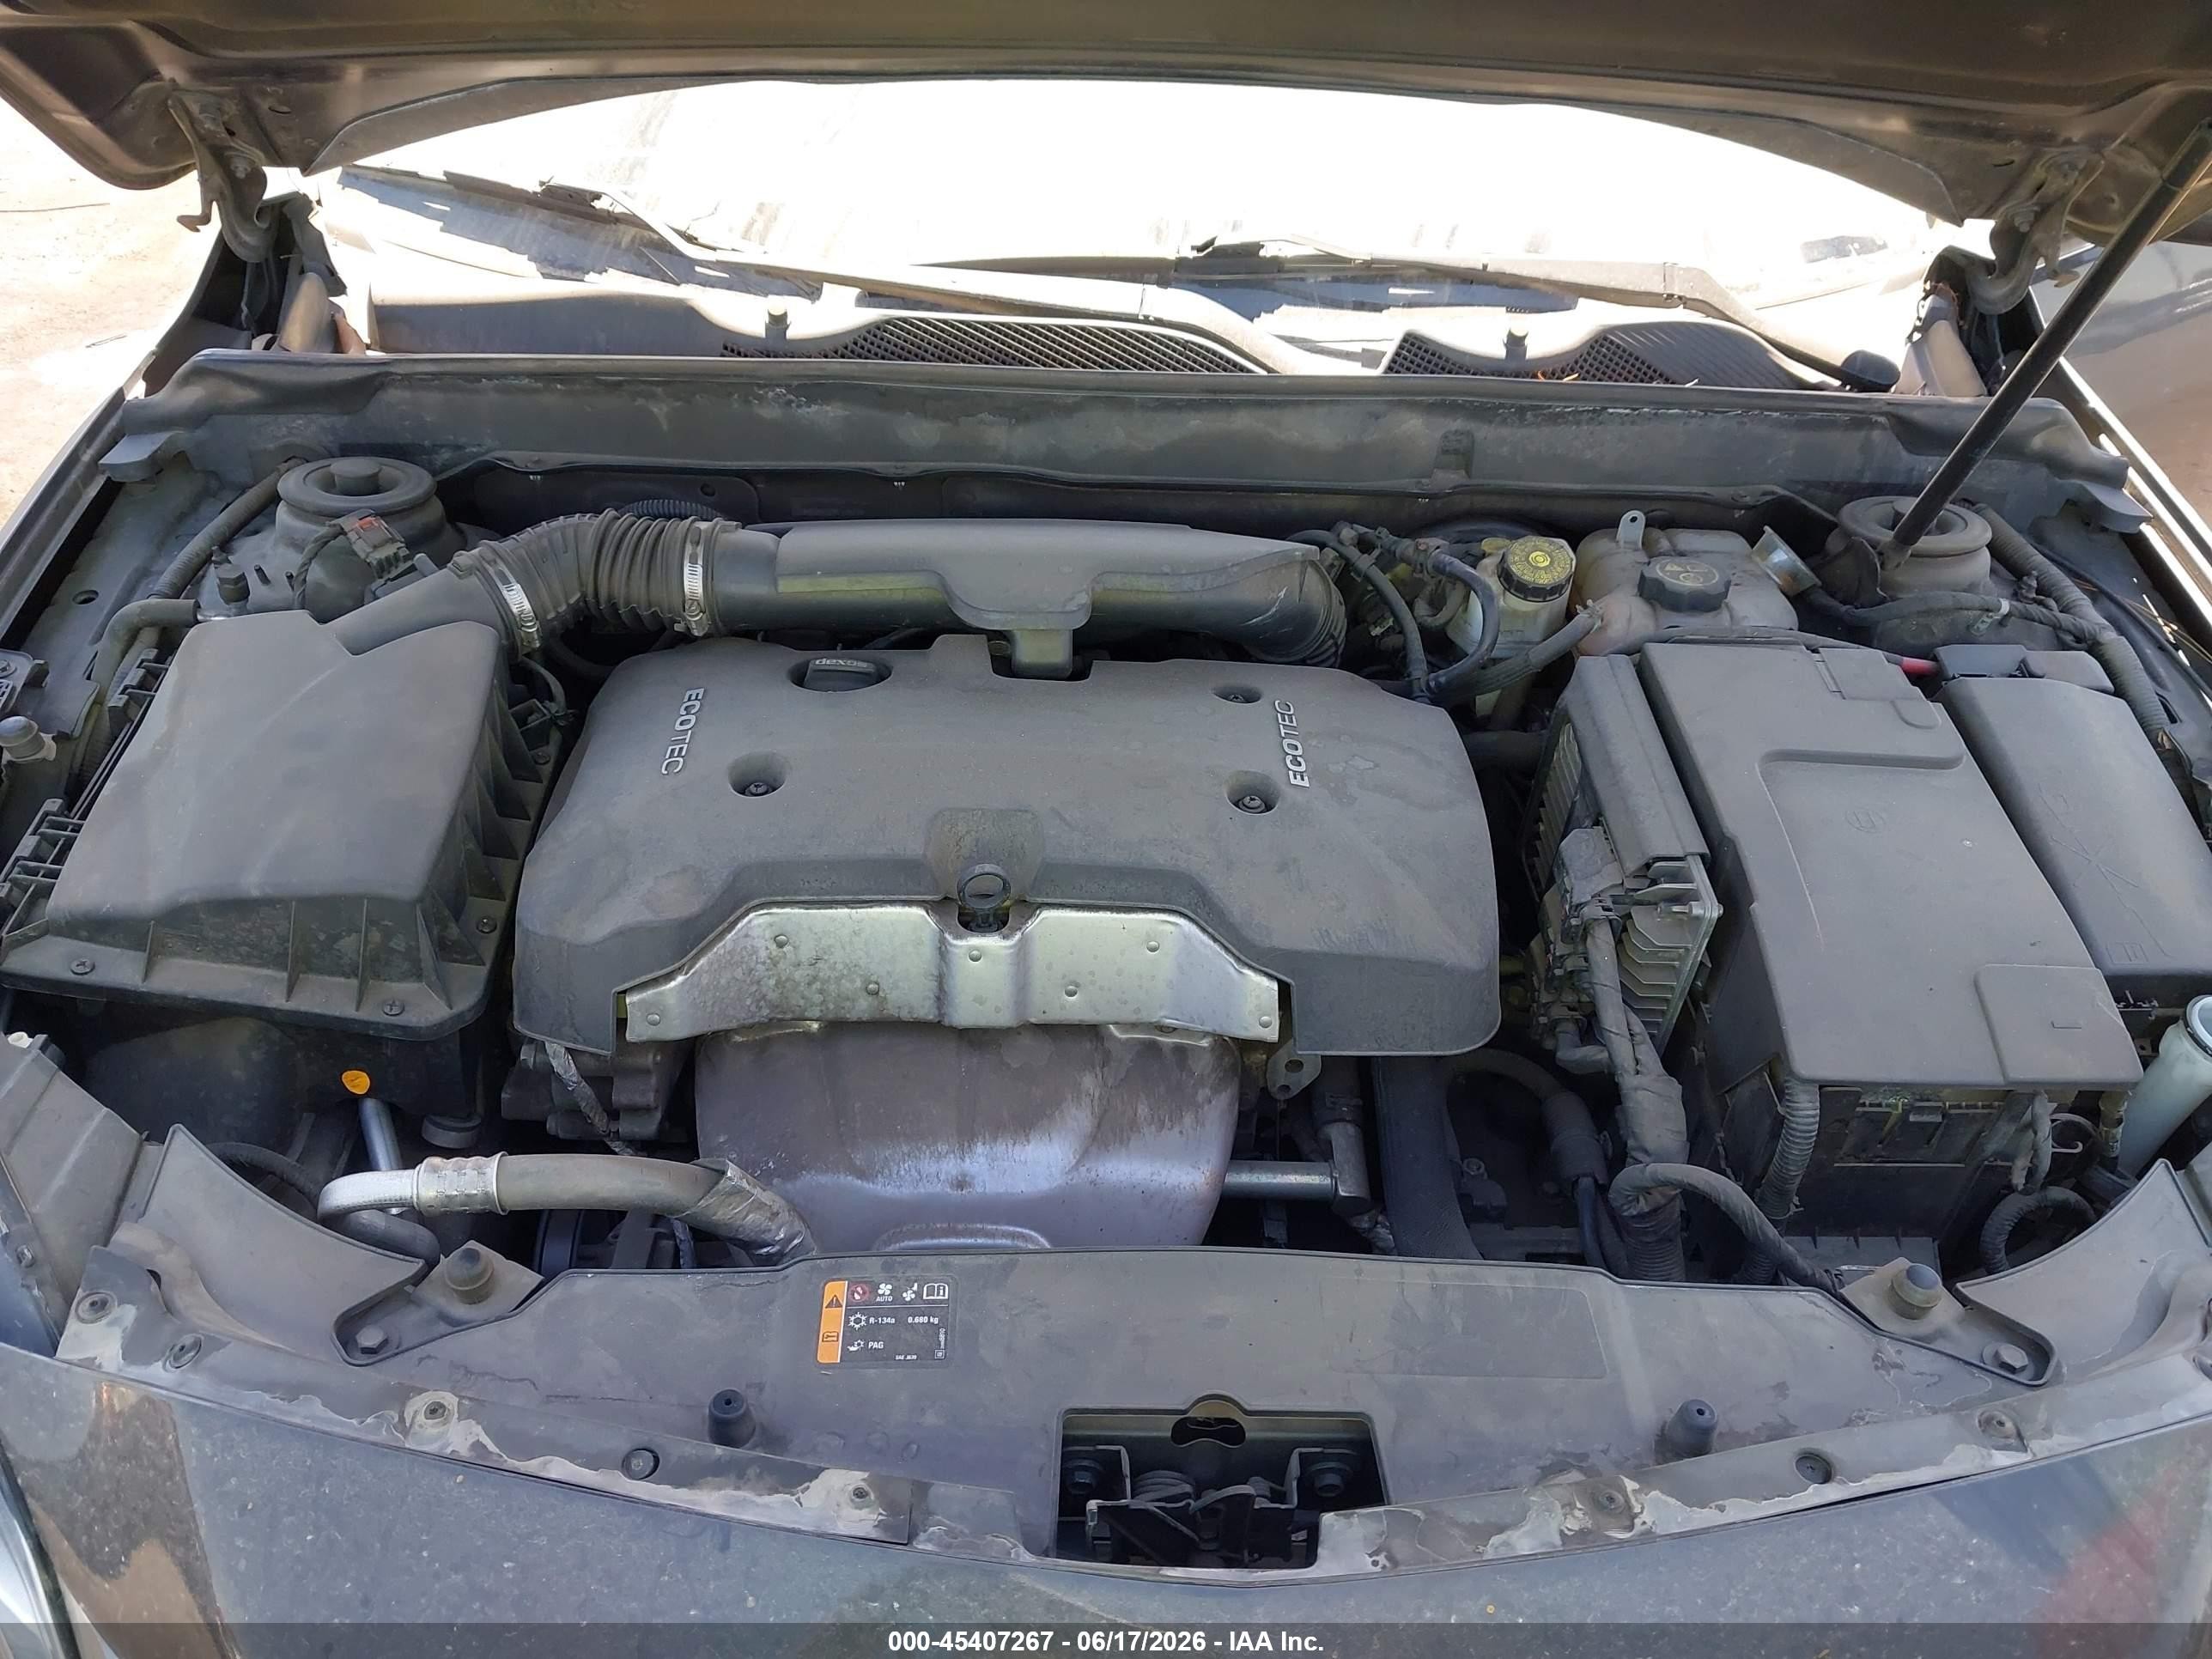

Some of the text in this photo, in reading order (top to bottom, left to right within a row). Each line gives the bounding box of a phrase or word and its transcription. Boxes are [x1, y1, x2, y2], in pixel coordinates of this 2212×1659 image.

[661, 688, 705, 775] ECOTEC
[1274, 700, 1310, 787] ECOTEC
[930, 1316, 939, 1324] kg
[868, 1340, 884, 1349] PAG
